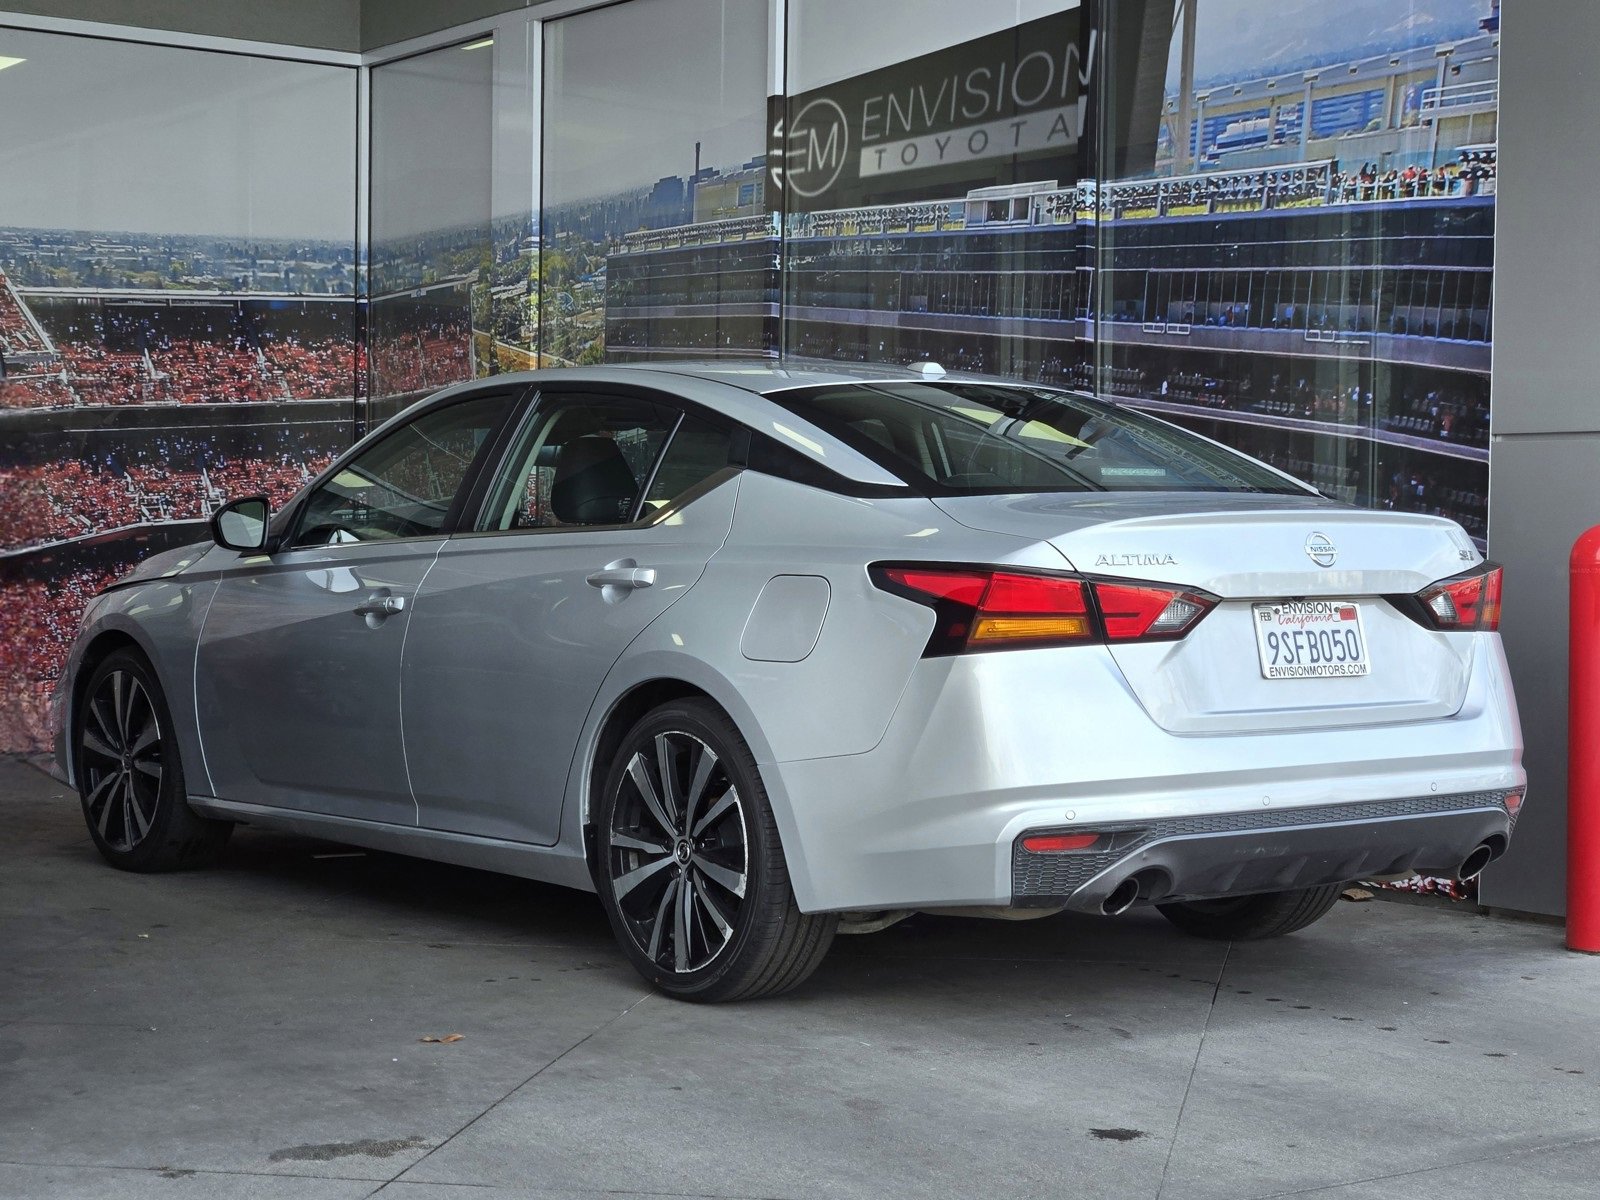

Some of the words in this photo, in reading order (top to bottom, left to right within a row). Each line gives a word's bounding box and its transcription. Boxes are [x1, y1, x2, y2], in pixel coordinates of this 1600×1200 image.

[861, 29, 1097, 141] ENVISION
[875, 112, 1071, 169] TOYOTA
[1095, 553, 1179, 566] ALTIMA
[1281, 602, 1333, 615] ENVISION
[1260, 611, 1272, 622] FEB
[1278, 614, 1334, 629] California
[1267, 629, 1360, 665] 9SFB050
[1269, 664, 1368, 677] ENVISIONMOTORS.COM
